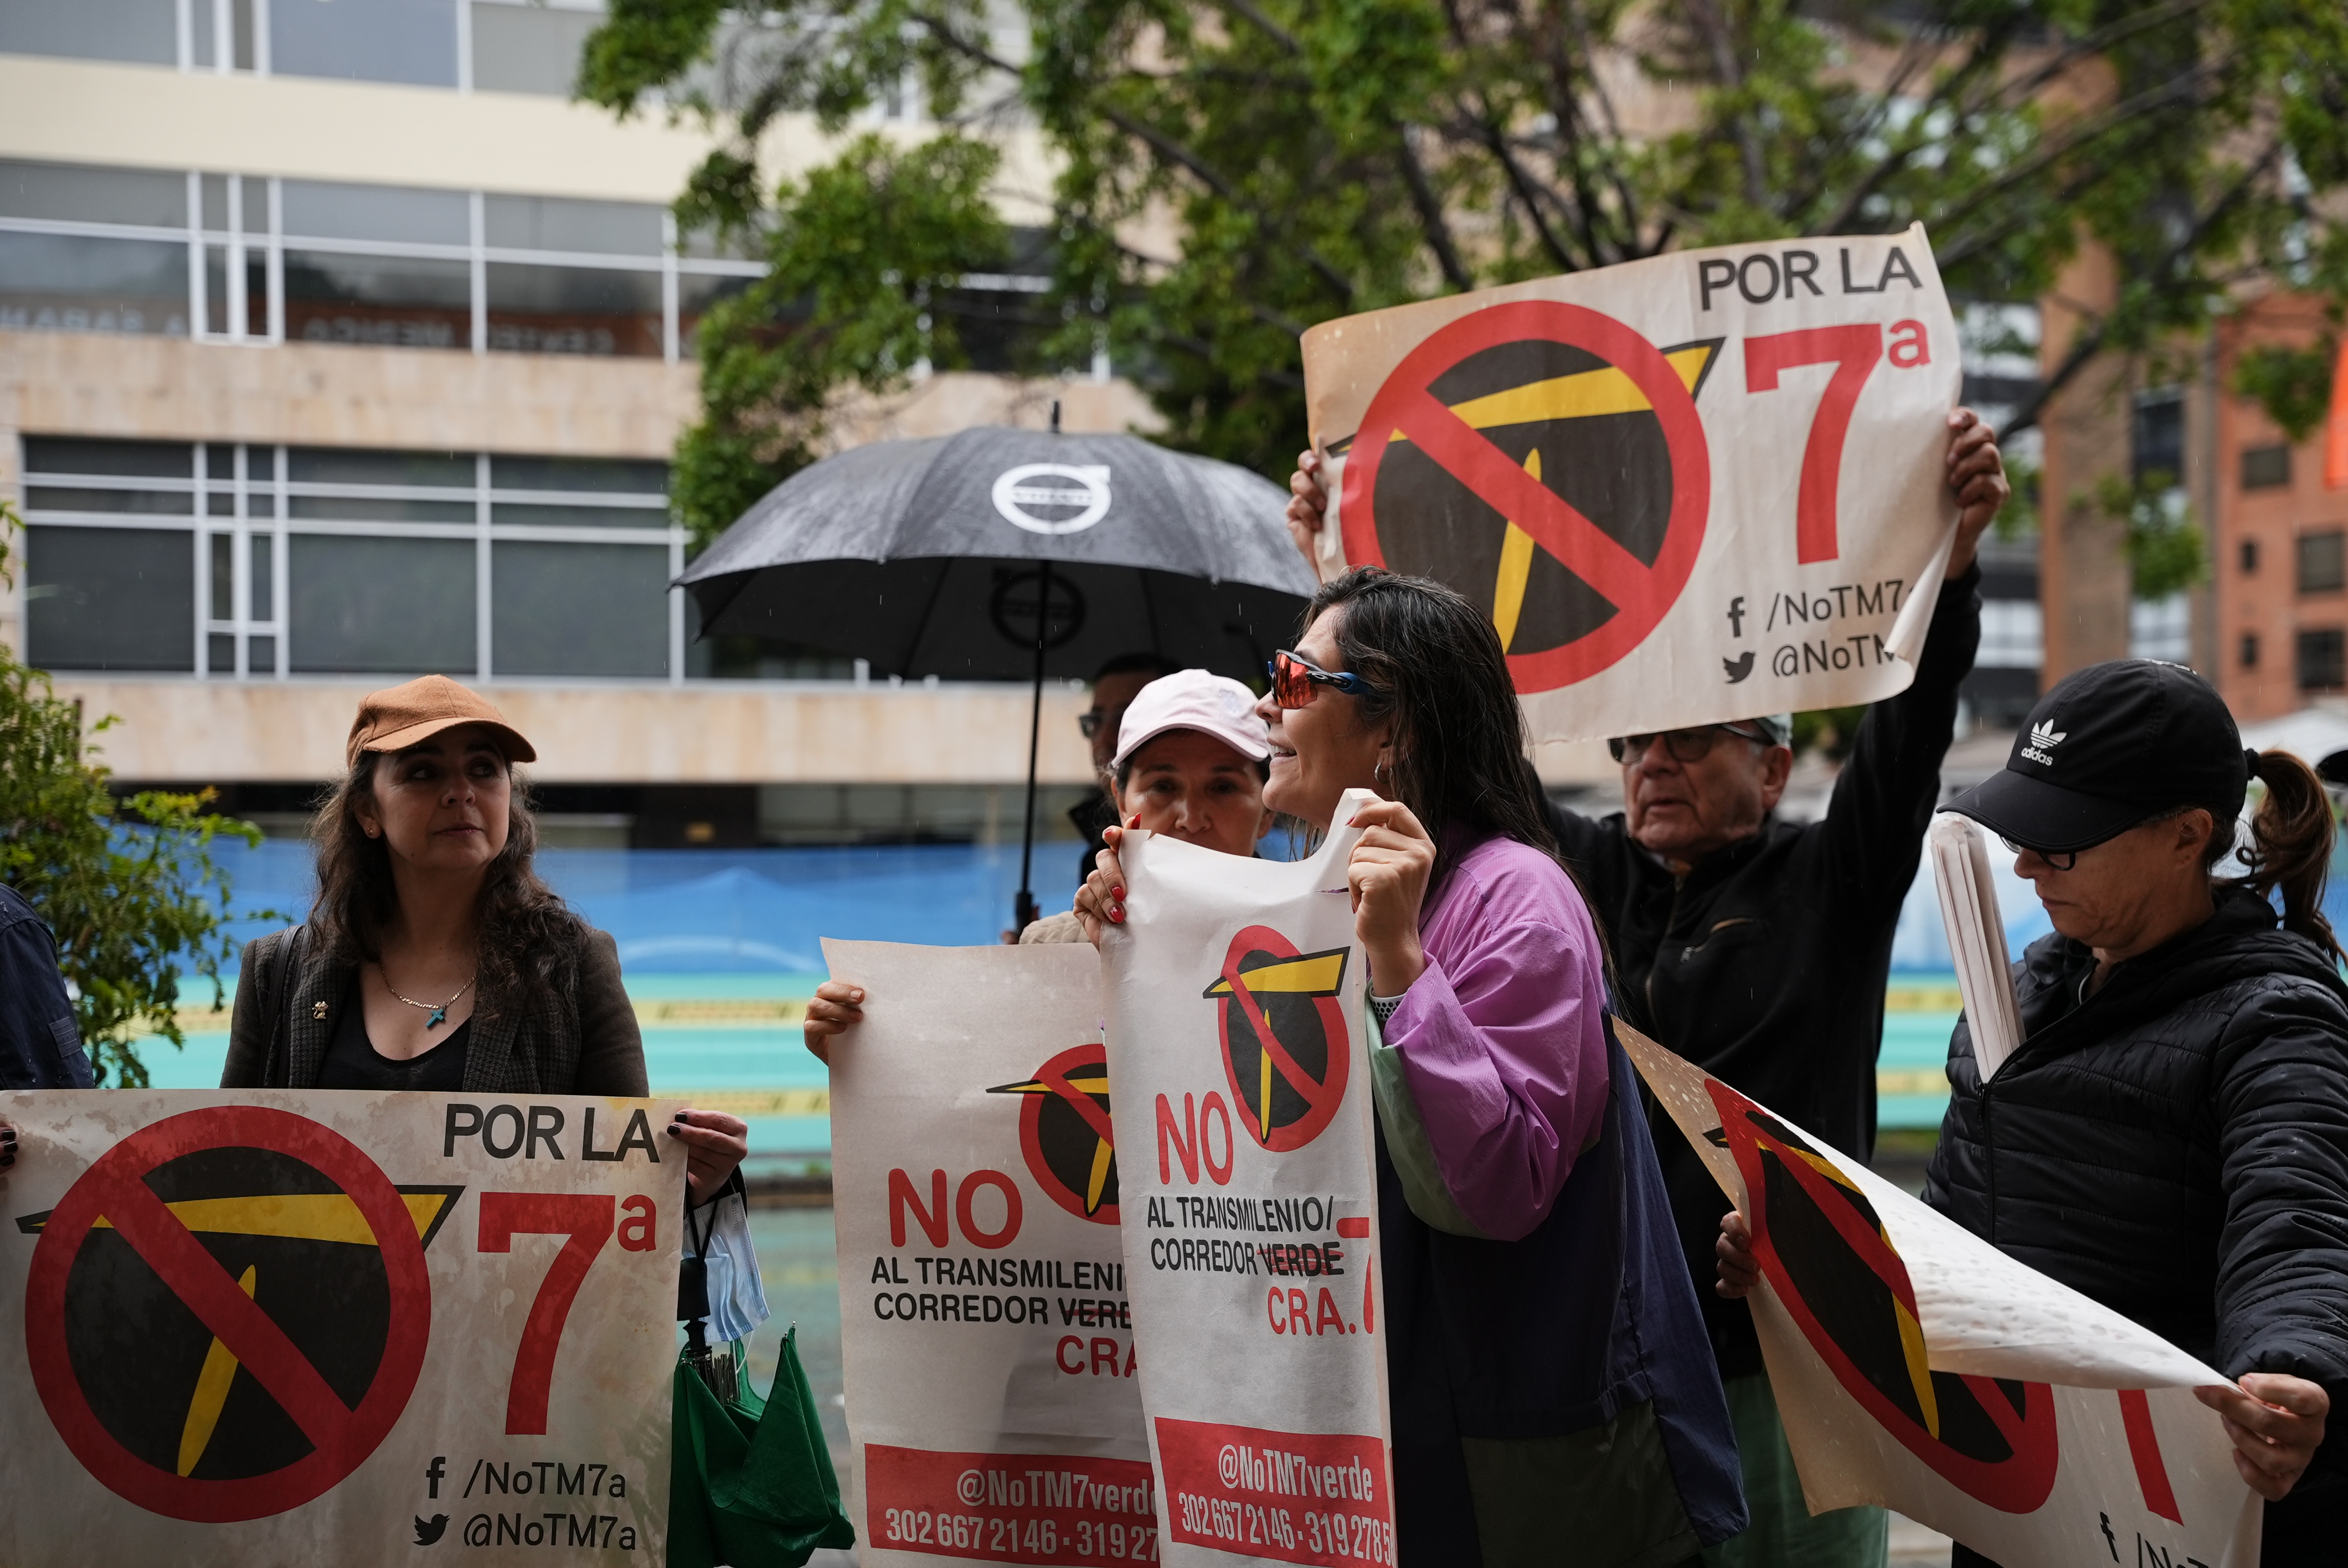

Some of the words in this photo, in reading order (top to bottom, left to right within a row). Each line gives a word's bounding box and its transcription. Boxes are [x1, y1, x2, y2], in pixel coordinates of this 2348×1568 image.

[1699, 250, 1824, 311] POR
[1840, 246, 1922, 294] LA
[1767, 579, 1912, 633] /NoTM7
[2021, 747, 2053, 766] adidas
[444, 1103, 565, 1160] POR
[582, 1107, 660, 1163] LA
[1155, 1091, 1234, 1185] NO
[888, 1168, 1023, 1249] NO
[1147, 1196, 1174, 1228] AL
[1177, 1195, 1333, 1232] TRANSMILENIO/
[872, 1257, 909, 1284] AL
[915, 1257, 1126, 1292] TRANSMILENI
[1151, 1238, 1258, 1276] CORREDOR
[1259, 1241, 1345, 1277] VERDE
[874, 1293, 1048, 1325] CORREDOR
[1268, 1287, 1356, 1335] CRA.
[463, 1459, 626, 1498] /NoTM7a
[1218, 1444, 1373, 1502] @NoTM7verde
[464, 1513, 636, 1550] @NoTM7a
[885, 1508, 934, 1544] 302
[937, 1513, 984, 1549] 667
[1077, 1521, 1125, 1558] 319
